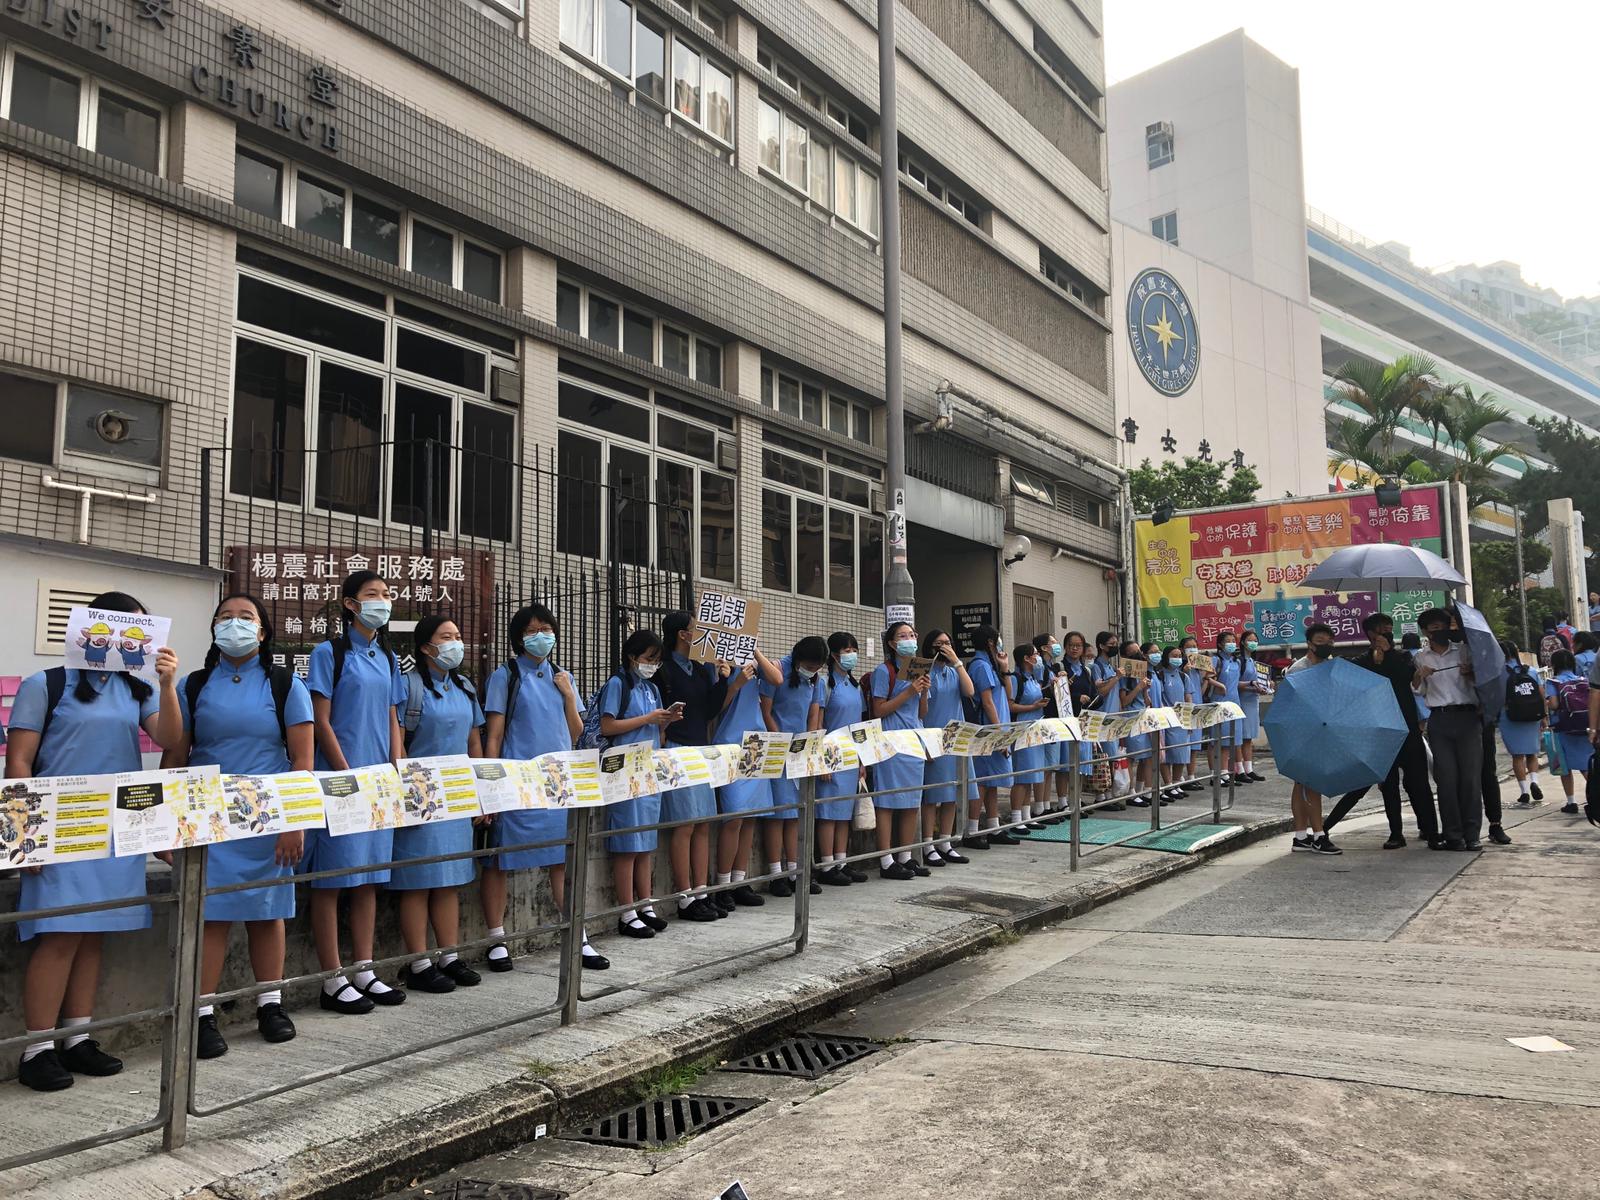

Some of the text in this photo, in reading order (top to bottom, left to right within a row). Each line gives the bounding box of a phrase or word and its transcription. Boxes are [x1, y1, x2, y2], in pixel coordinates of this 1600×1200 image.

[191, 63, 340, 153] CHURCH
[1305, 512, 1343, 534] 喜樂
[1368, 517, 1389, 527] 中的
[1391, 504, 1431, 524] 倚靠
[1225, 521, 1258, 540] 保護
[1158, 547, 1178, 558] 中的
[251, 552, 466, 582] 楊震社會服務處
[1145, 558, 1181, 576] 亮光
[1196, 559, 1253, 580] 安素堂
[1205, 577, 1261, 600] 歡迎你
[88, 610, 156, 628] We connect.
[699, 592, 747, 630] 罷課
[1149, 627, 1179, 643] 共融
